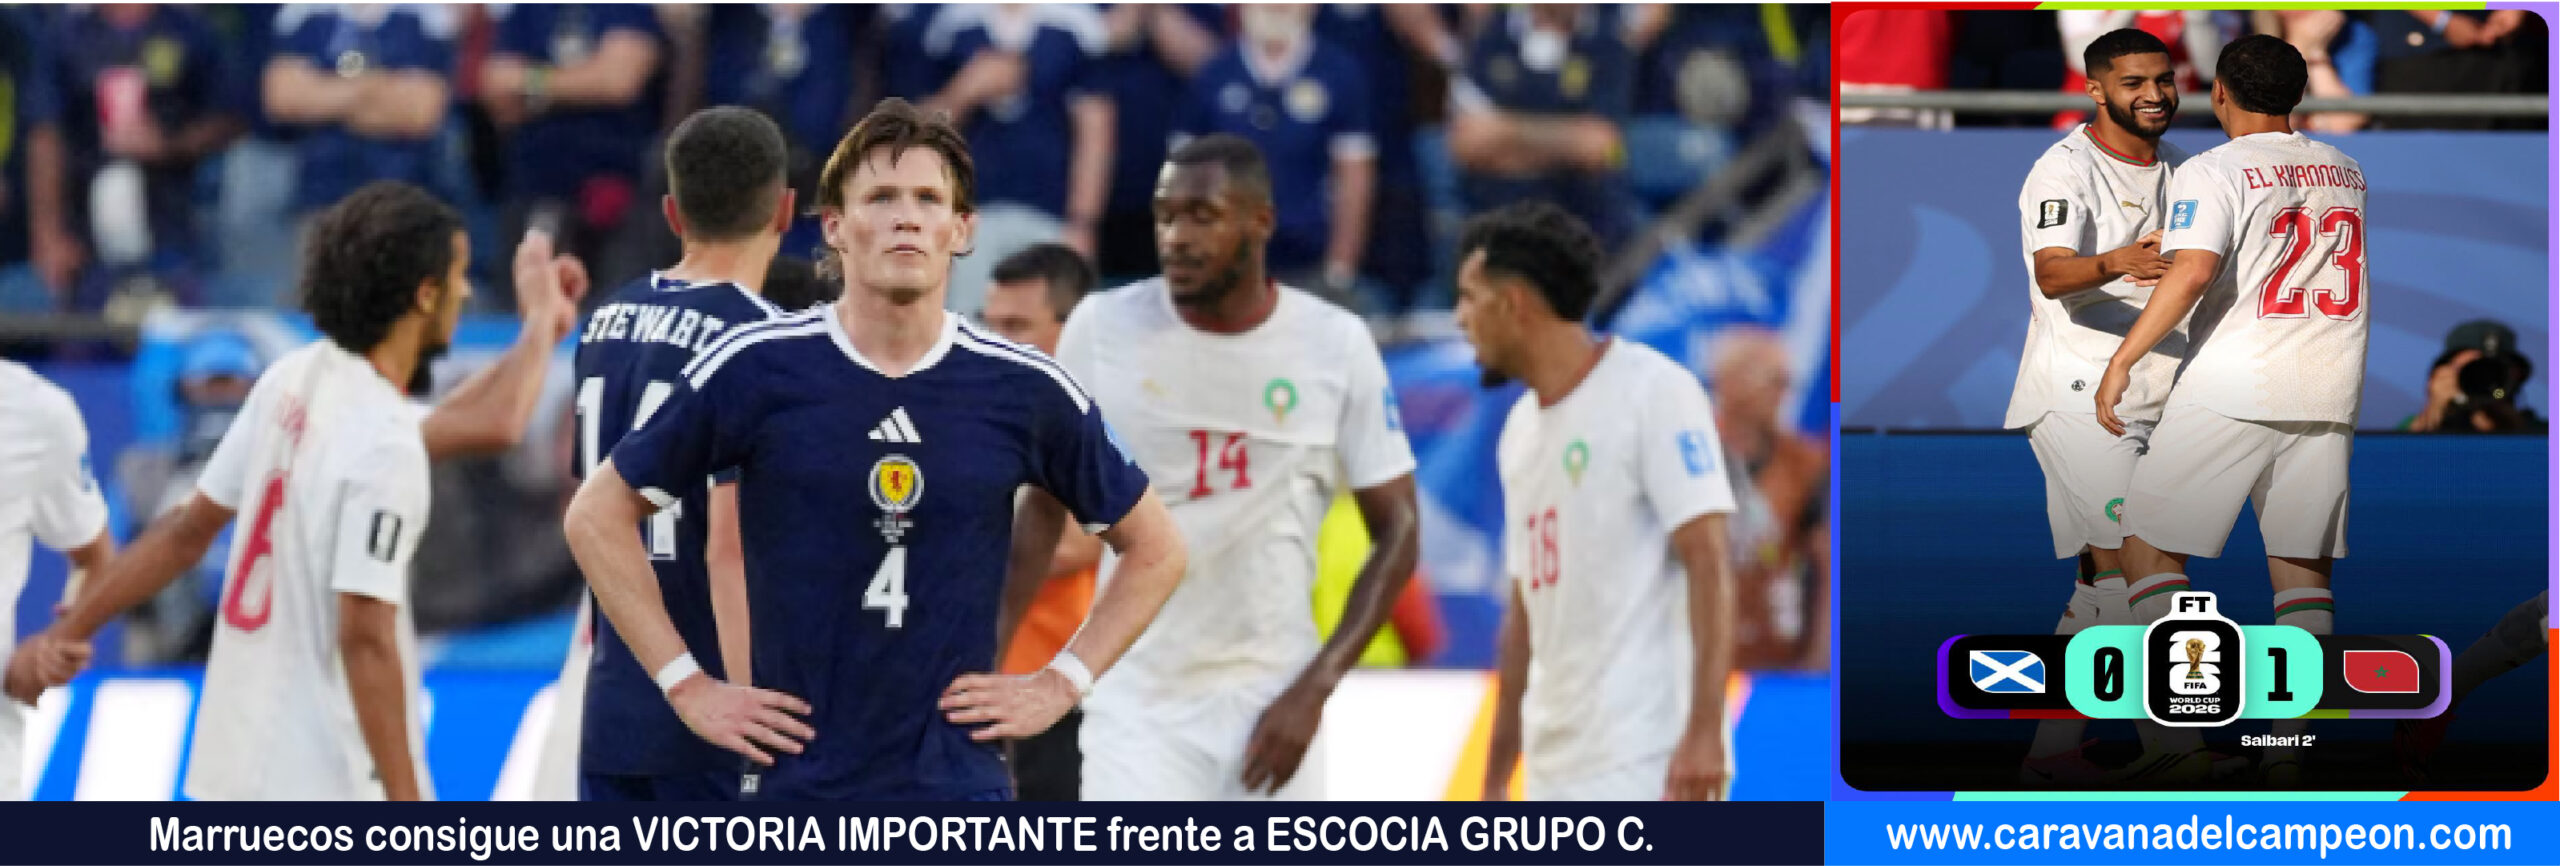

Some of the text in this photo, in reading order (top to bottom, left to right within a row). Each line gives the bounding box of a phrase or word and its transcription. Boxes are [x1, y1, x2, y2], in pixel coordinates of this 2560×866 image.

[2243, 168, 2273, 190] EL
[2257, 206, 2366, 321] 23
[580, 302, 726, 355] STEWART
[1188, 429, 1252, 498] 14
[861, 545, 909, 627] 4
[1525, 505, 1559, 592] 18
